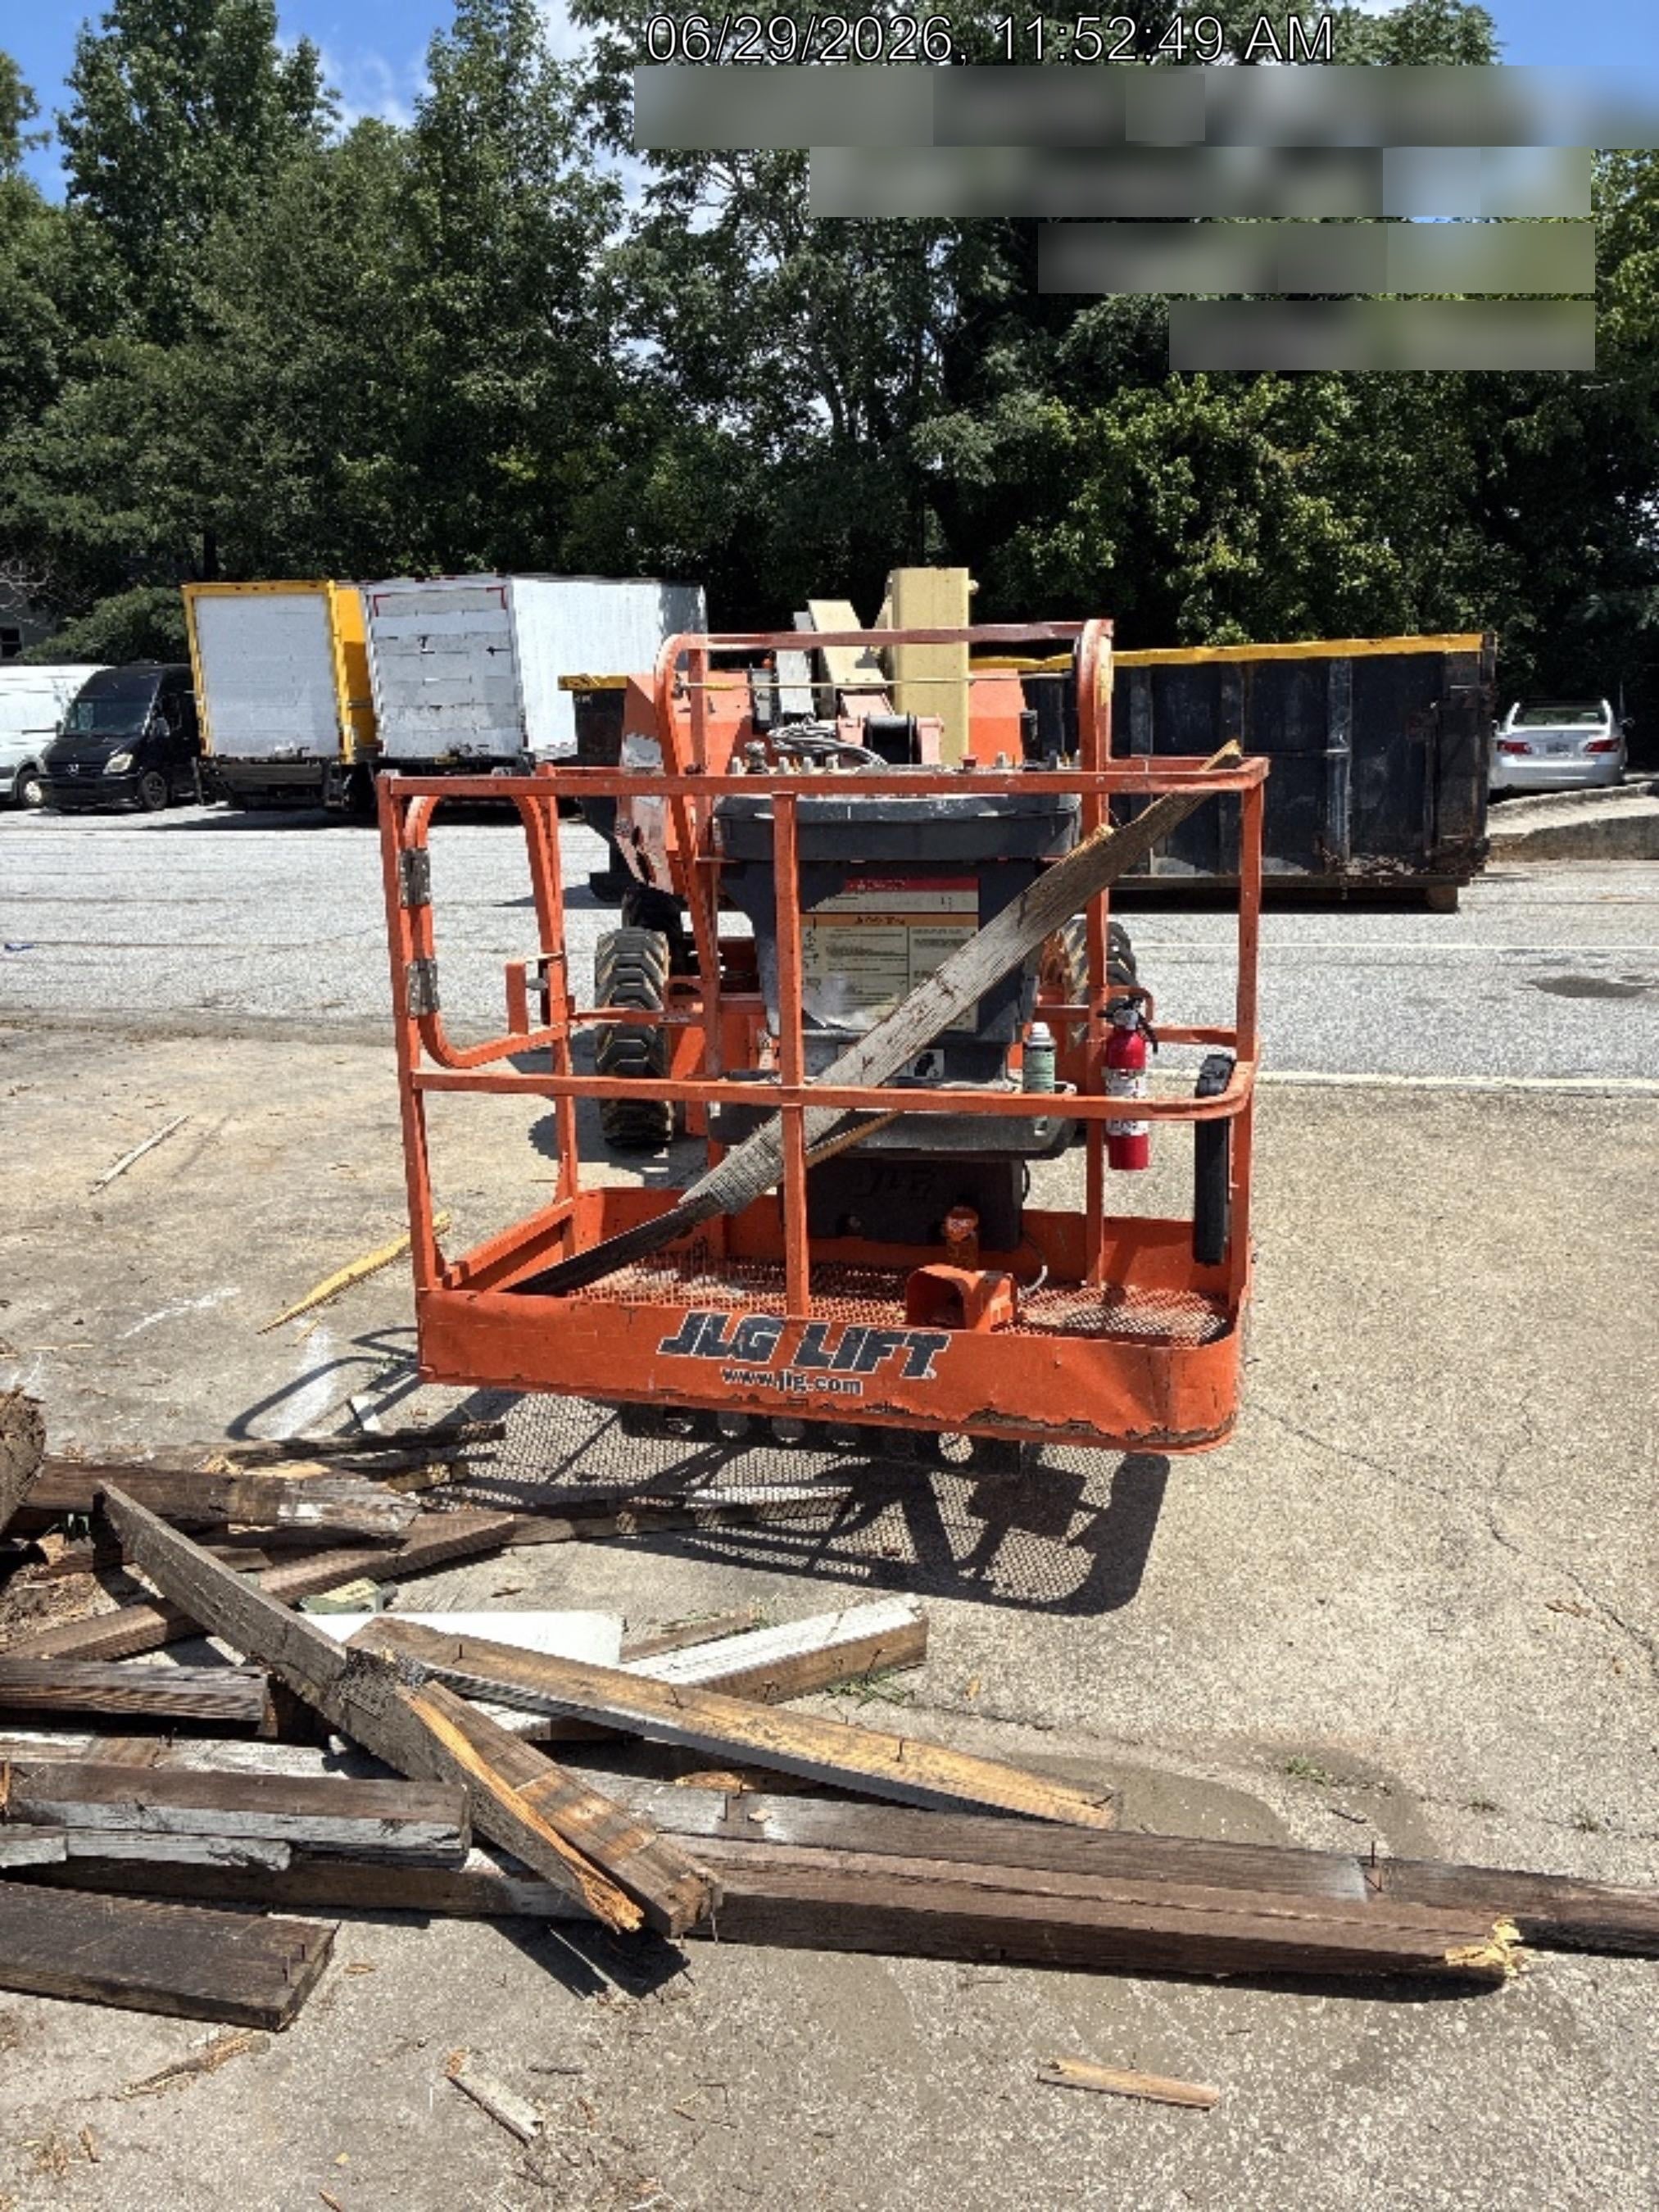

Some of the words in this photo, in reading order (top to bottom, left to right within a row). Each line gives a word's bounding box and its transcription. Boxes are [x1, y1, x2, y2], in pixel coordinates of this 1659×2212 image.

[657, 1311, 786, 1364] JLG
[791, 1322, 950, 1380] LIFT
[721, 1367, 863, 1396] www.jlg.com
